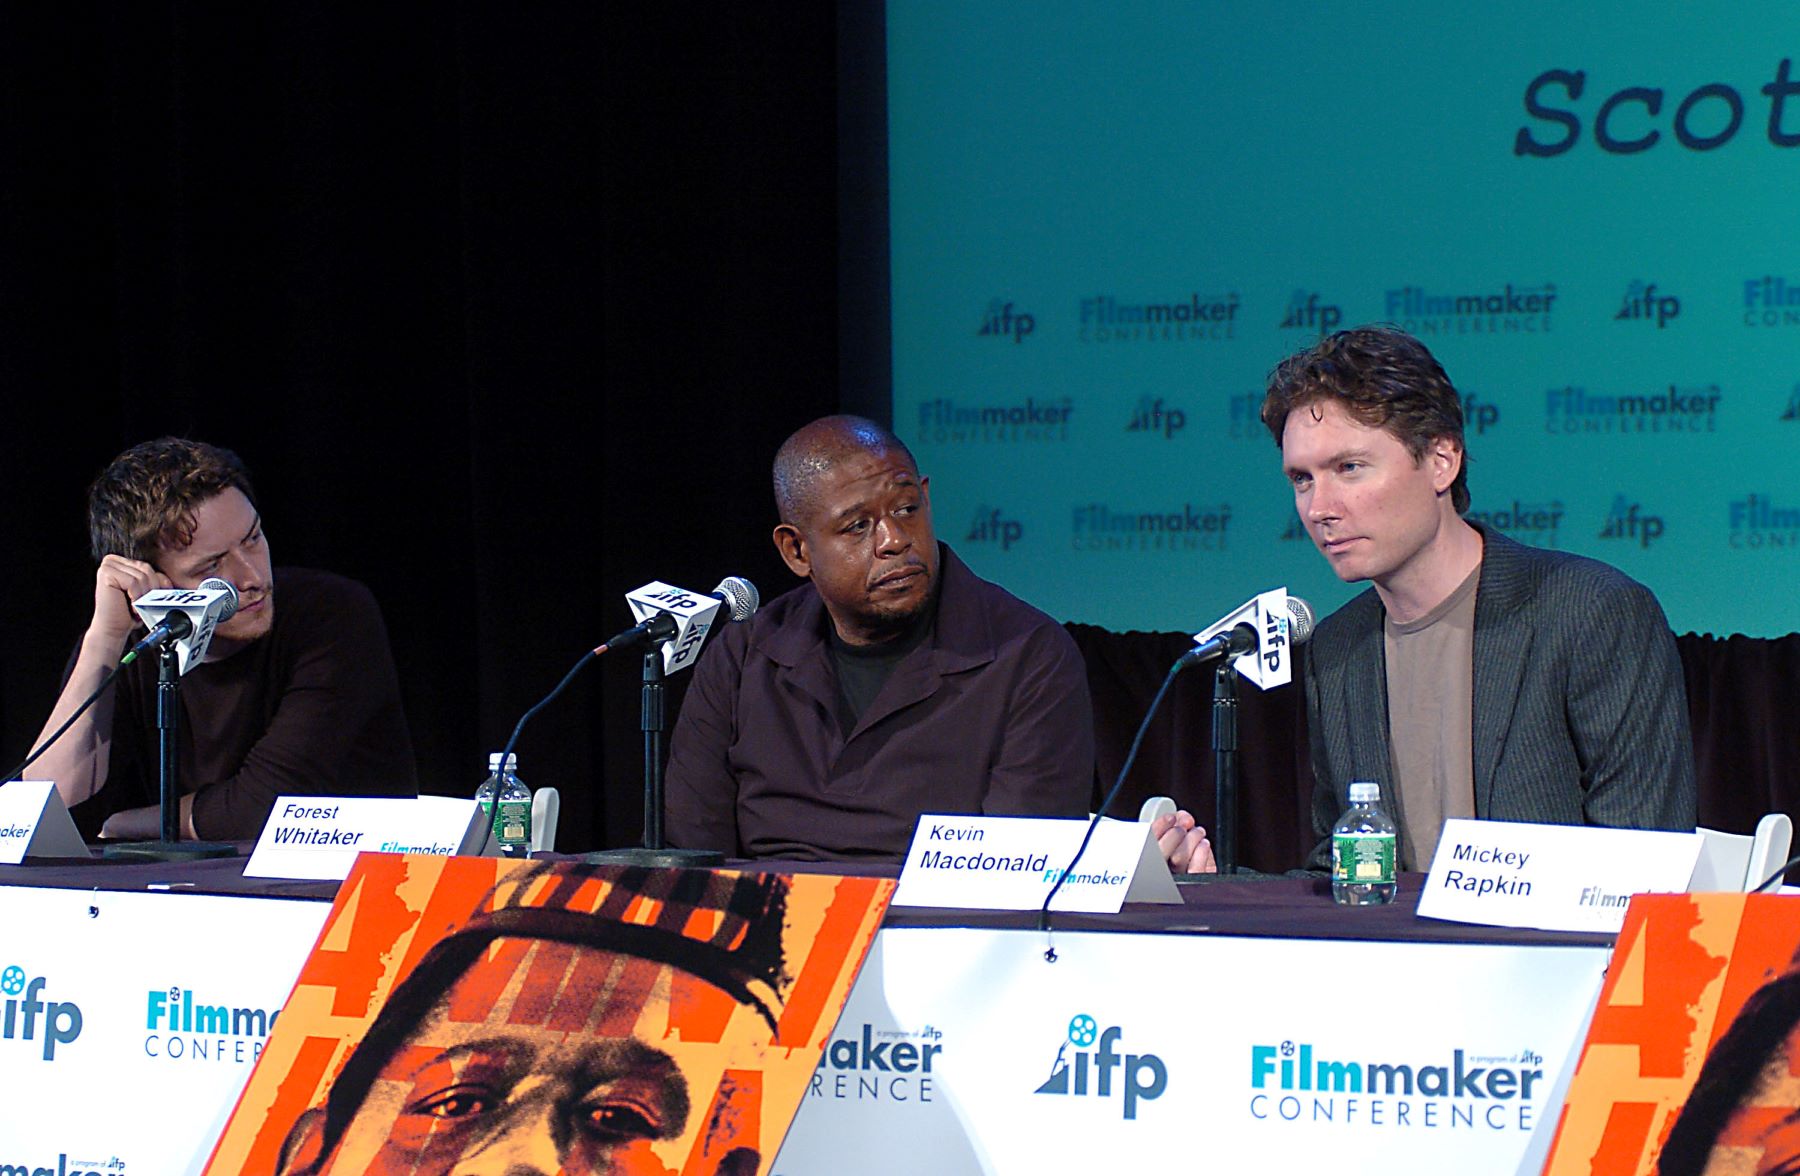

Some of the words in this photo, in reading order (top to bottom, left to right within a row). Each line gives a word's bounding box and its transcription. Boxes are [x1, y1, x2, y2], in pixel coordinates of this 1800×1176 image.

[1514, 58, 1800, 157] Scot
[1079, 294, 1240, 324] Filmmaker
[1385, 284, 1557, 318] Filmmaker
[1628, 281, 1680, 329] ifp
[988, 299, 1036, 343] ifp
[919, 398, 1073, 426] Filmmaker
[1140, 396, 1185, 439] ifp
[1546, 386, 1721, 415] Filmmaker
[975, 505, 1022, 550] ifp
[1072, 504, 1232, 533] Filmmaker
[1611, 497, 1665, 548] ifp
[658, 590, 698, 609] ifp
[672, 628, 706, 664] ifp
[1264, 622, 1287, 673] ifp
[283, 804, 339, 819] Forest
[0, 824, 29, 838] aker
[274, 827, 363, 845] Whitaker
[930, 825, 984, 841] Kevin
[920, 850, 1048, 872] Macdonald
[1452, 844, 1530, 870] Mickey
[1444, 870, 1532, 897] Rapkin
[1, 967, 83, 1061] ifp
[818, 1024, 942, 1073] aker
[1069, 1013, 1168, 1120] ifp
[1252, 1040, 1543, 1100] Filmmaker
[1250, 1095, 1532, 1130] CONFERENCE
